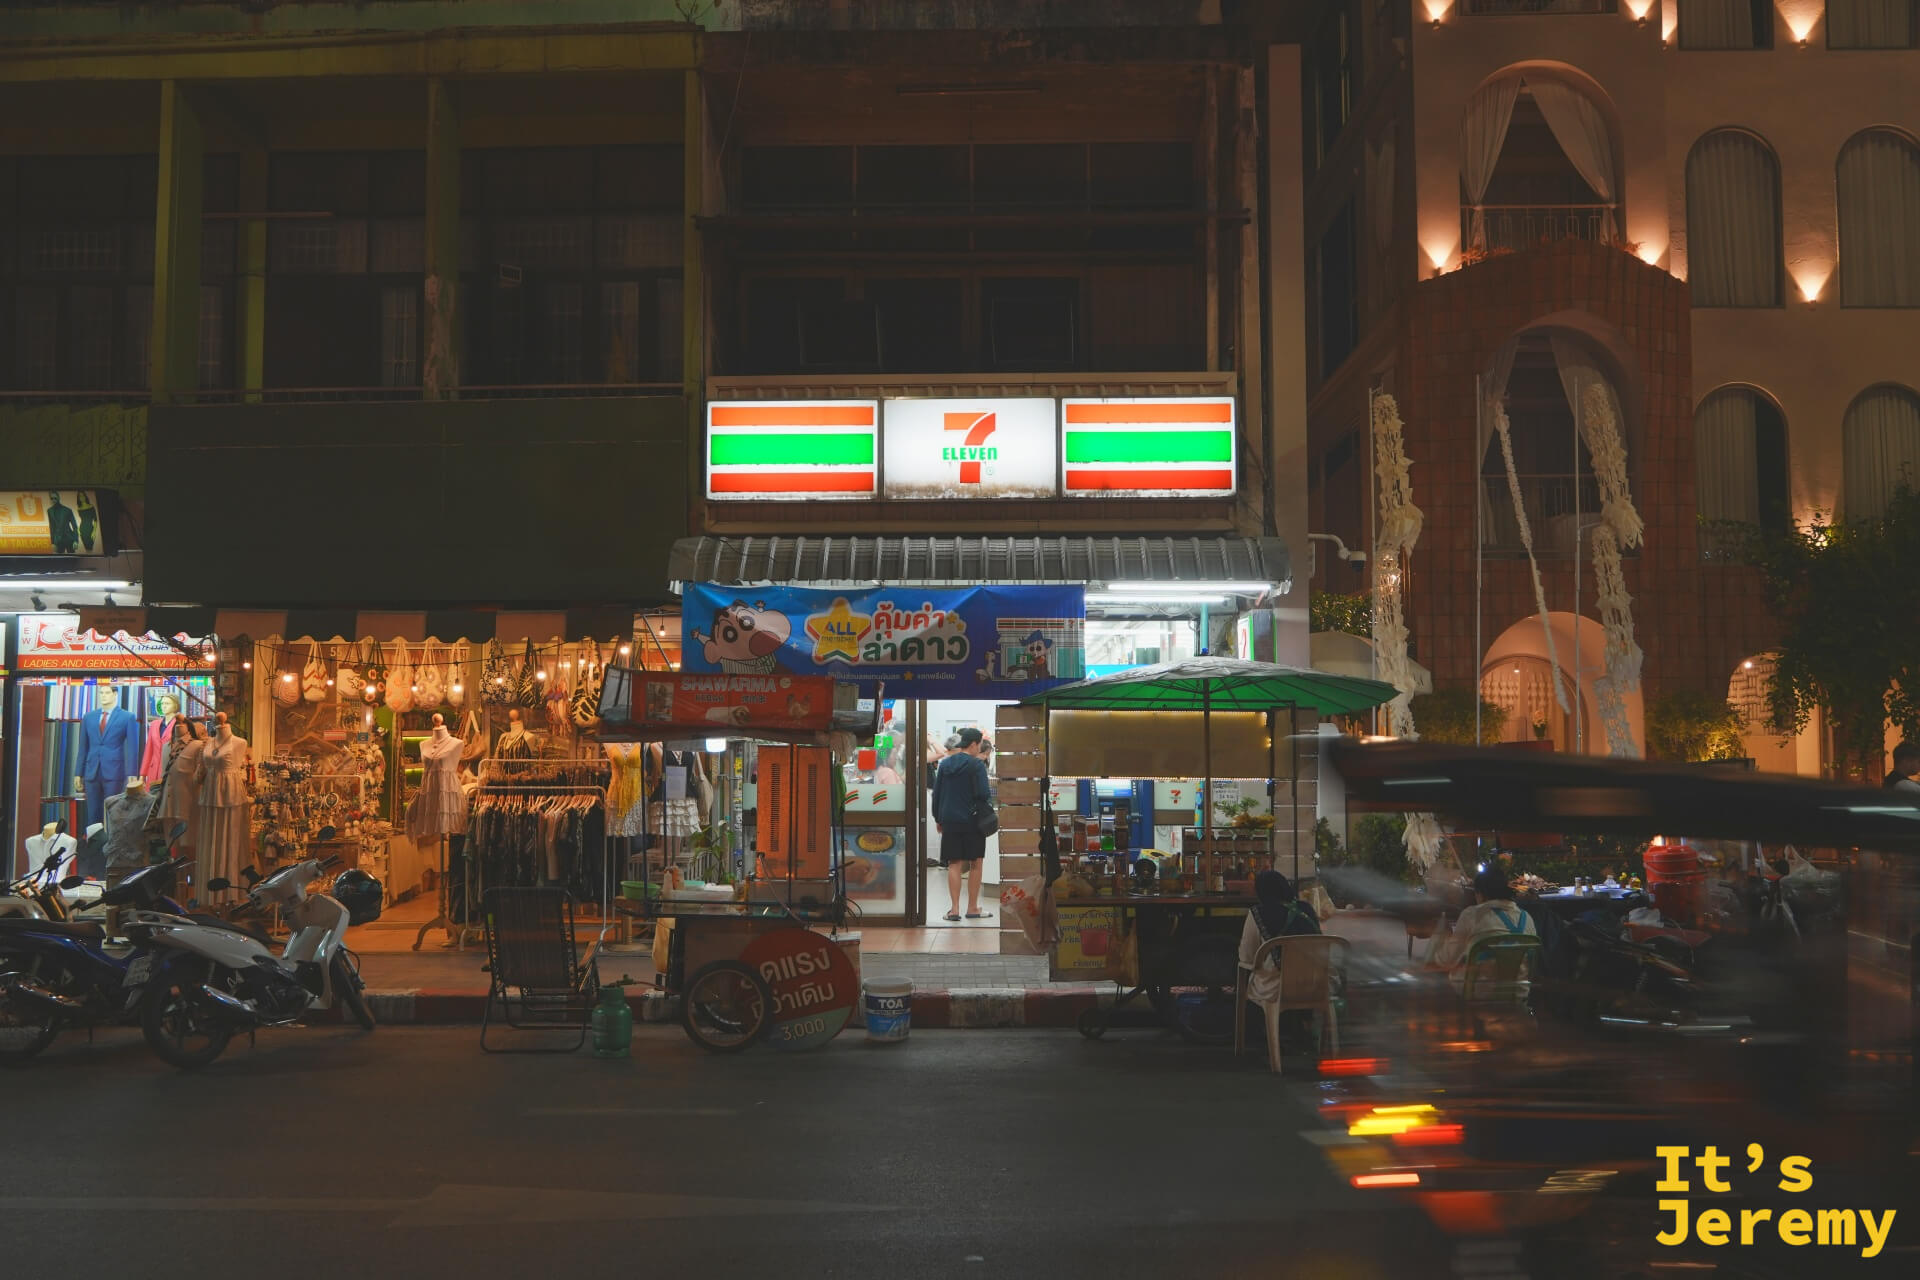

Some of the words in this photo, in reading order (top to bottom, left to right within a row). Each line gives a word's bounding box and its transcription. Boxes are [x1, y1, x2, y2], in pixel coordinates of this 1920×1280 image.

[944, 411, 996, 483] 7
[825, 621, 857, 636] ALL
[874, 603, 945, 639] คุ้มค่า
[862, 633, 968, 662] ล่าดาว
[23, 659, 58, 668] LADIES
[61, 659, 84, 668] AND
[86, 659, 120, 668] GENTS
[122, 659, 166, 668] CUSTOM
[680, 677, 777, 692] SHAWARMA
[878, 999, 904, 1009] TOA
[782, 1018, 825, 1041] 3,000
